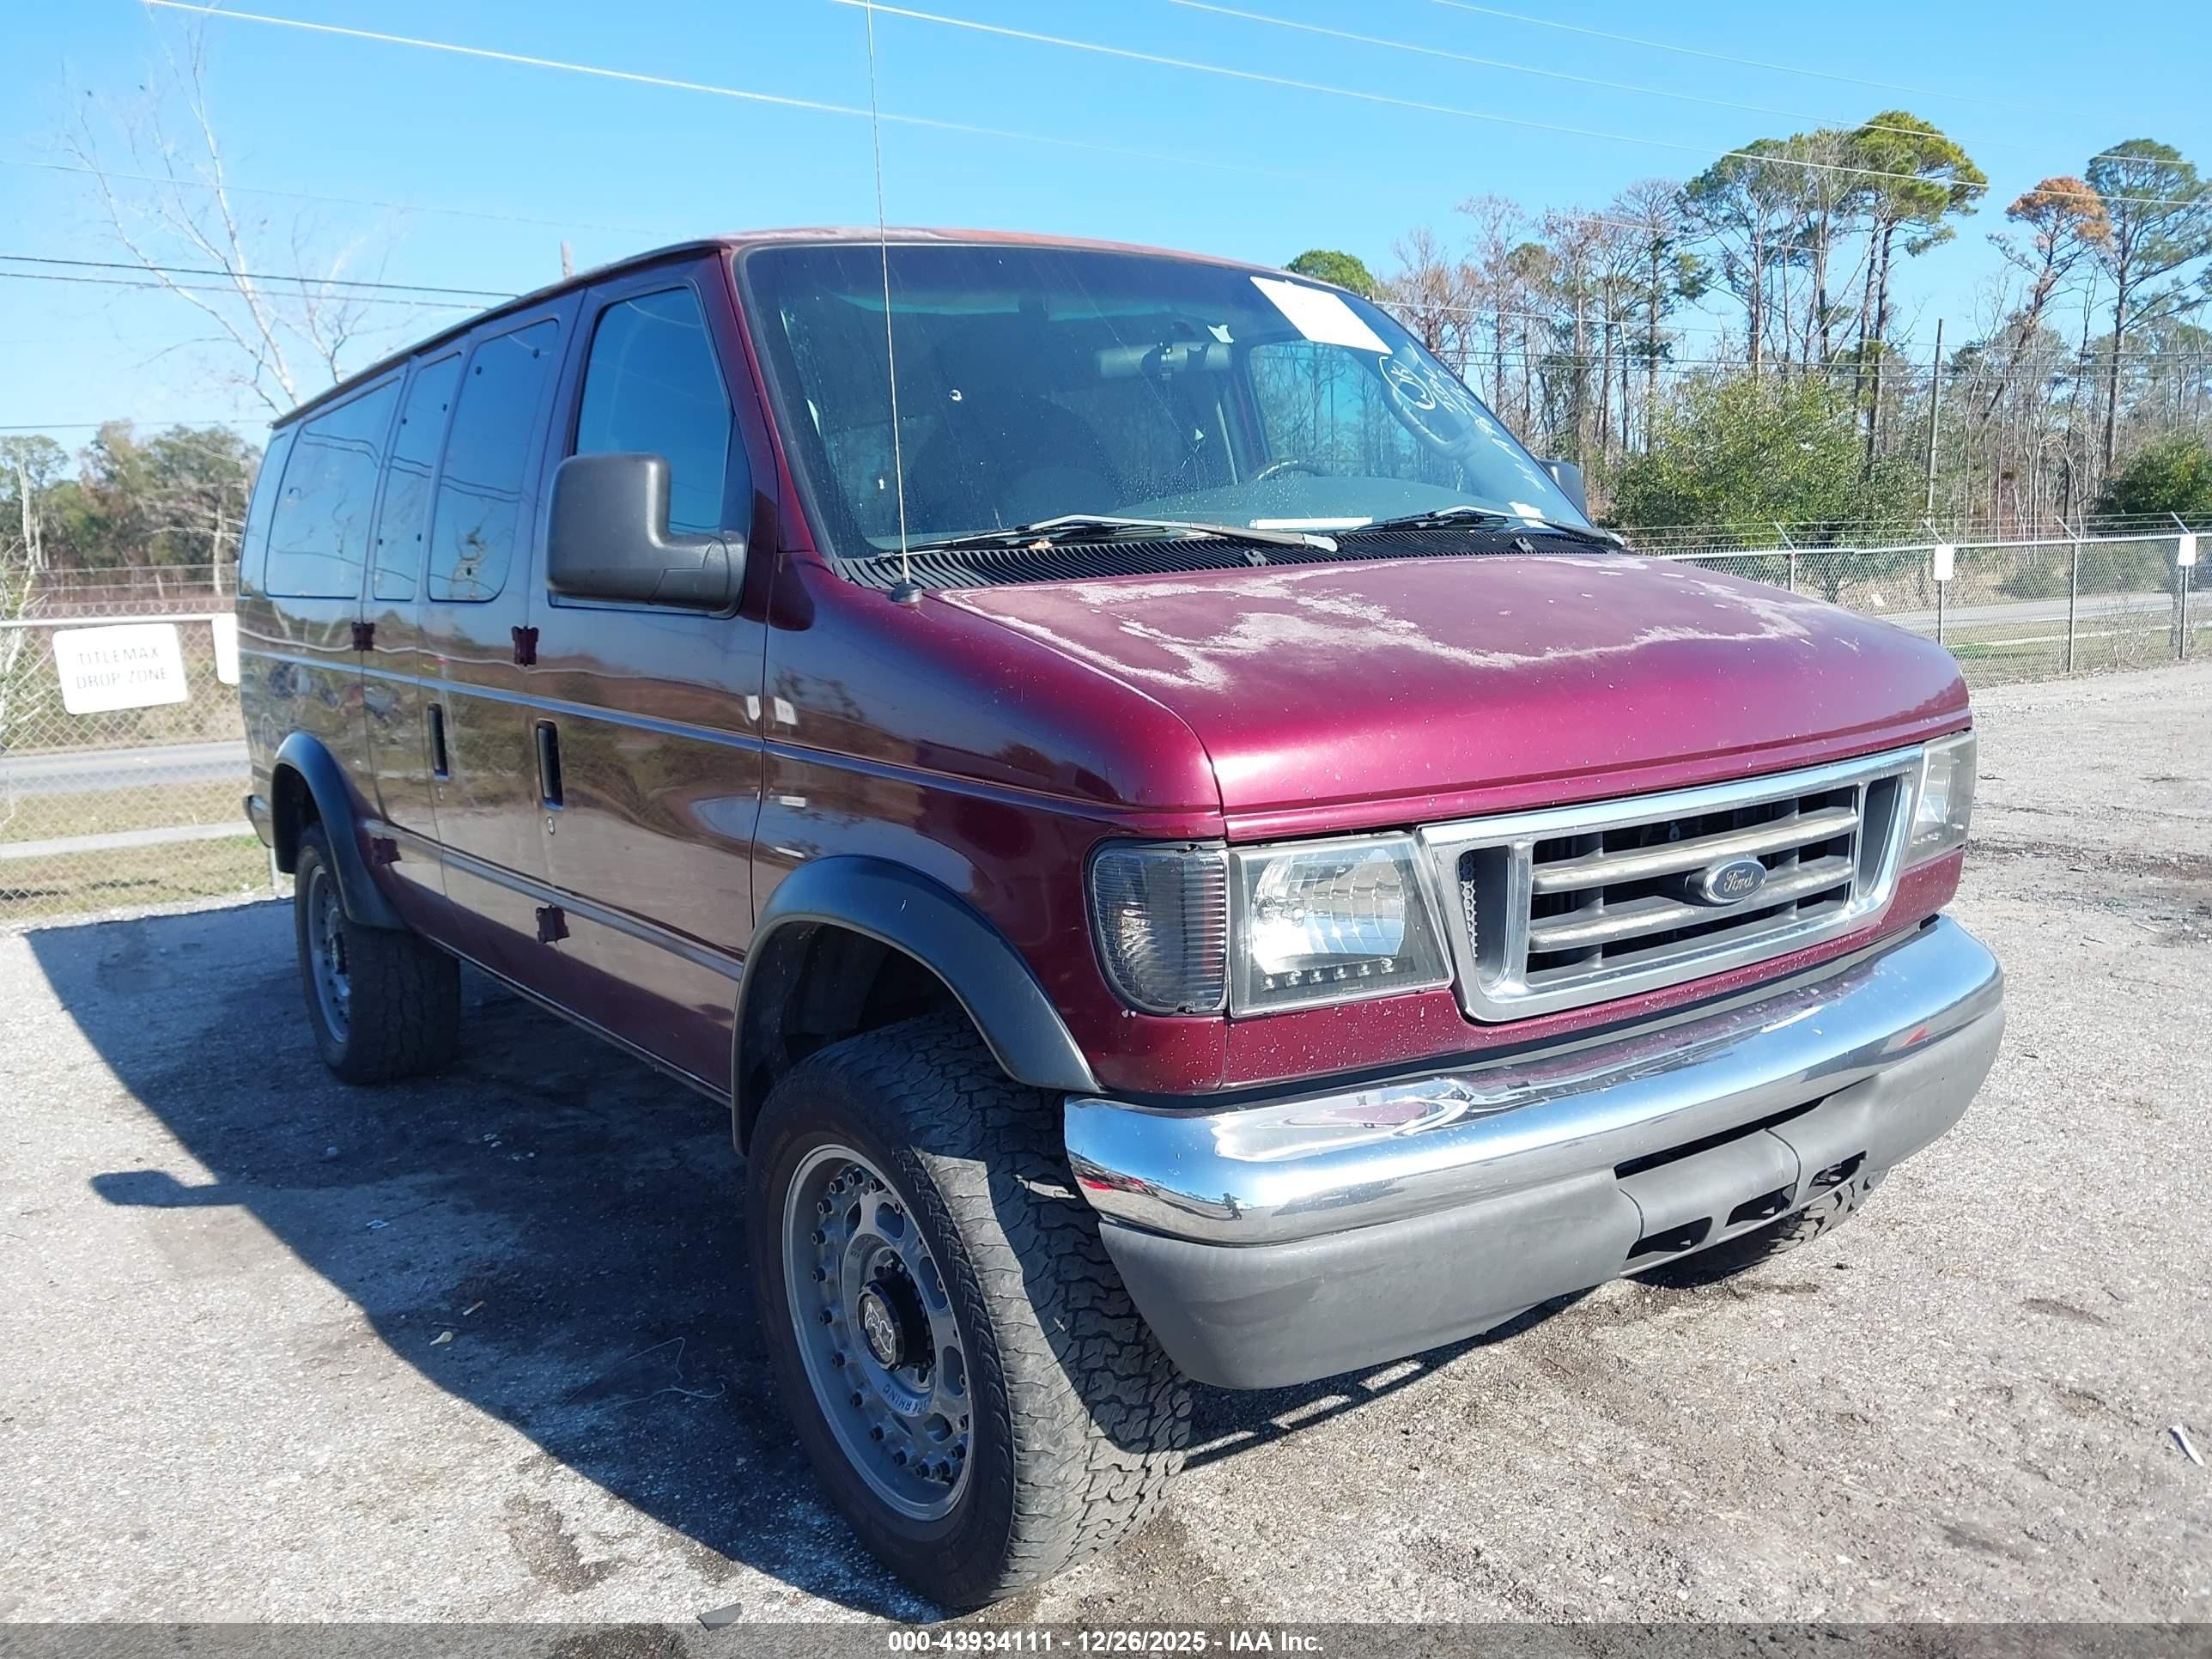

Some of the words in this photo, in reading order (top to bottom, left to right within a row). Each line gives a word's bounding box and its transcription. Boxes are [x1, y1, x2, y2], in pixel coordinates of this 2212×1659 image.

[76, 646, 160, 666] TITLEMAX
[76, 672, 121, 690] DROP
[128, 666, 168, 684] ZONE
[1723, 868, 1754, 893] Ford
